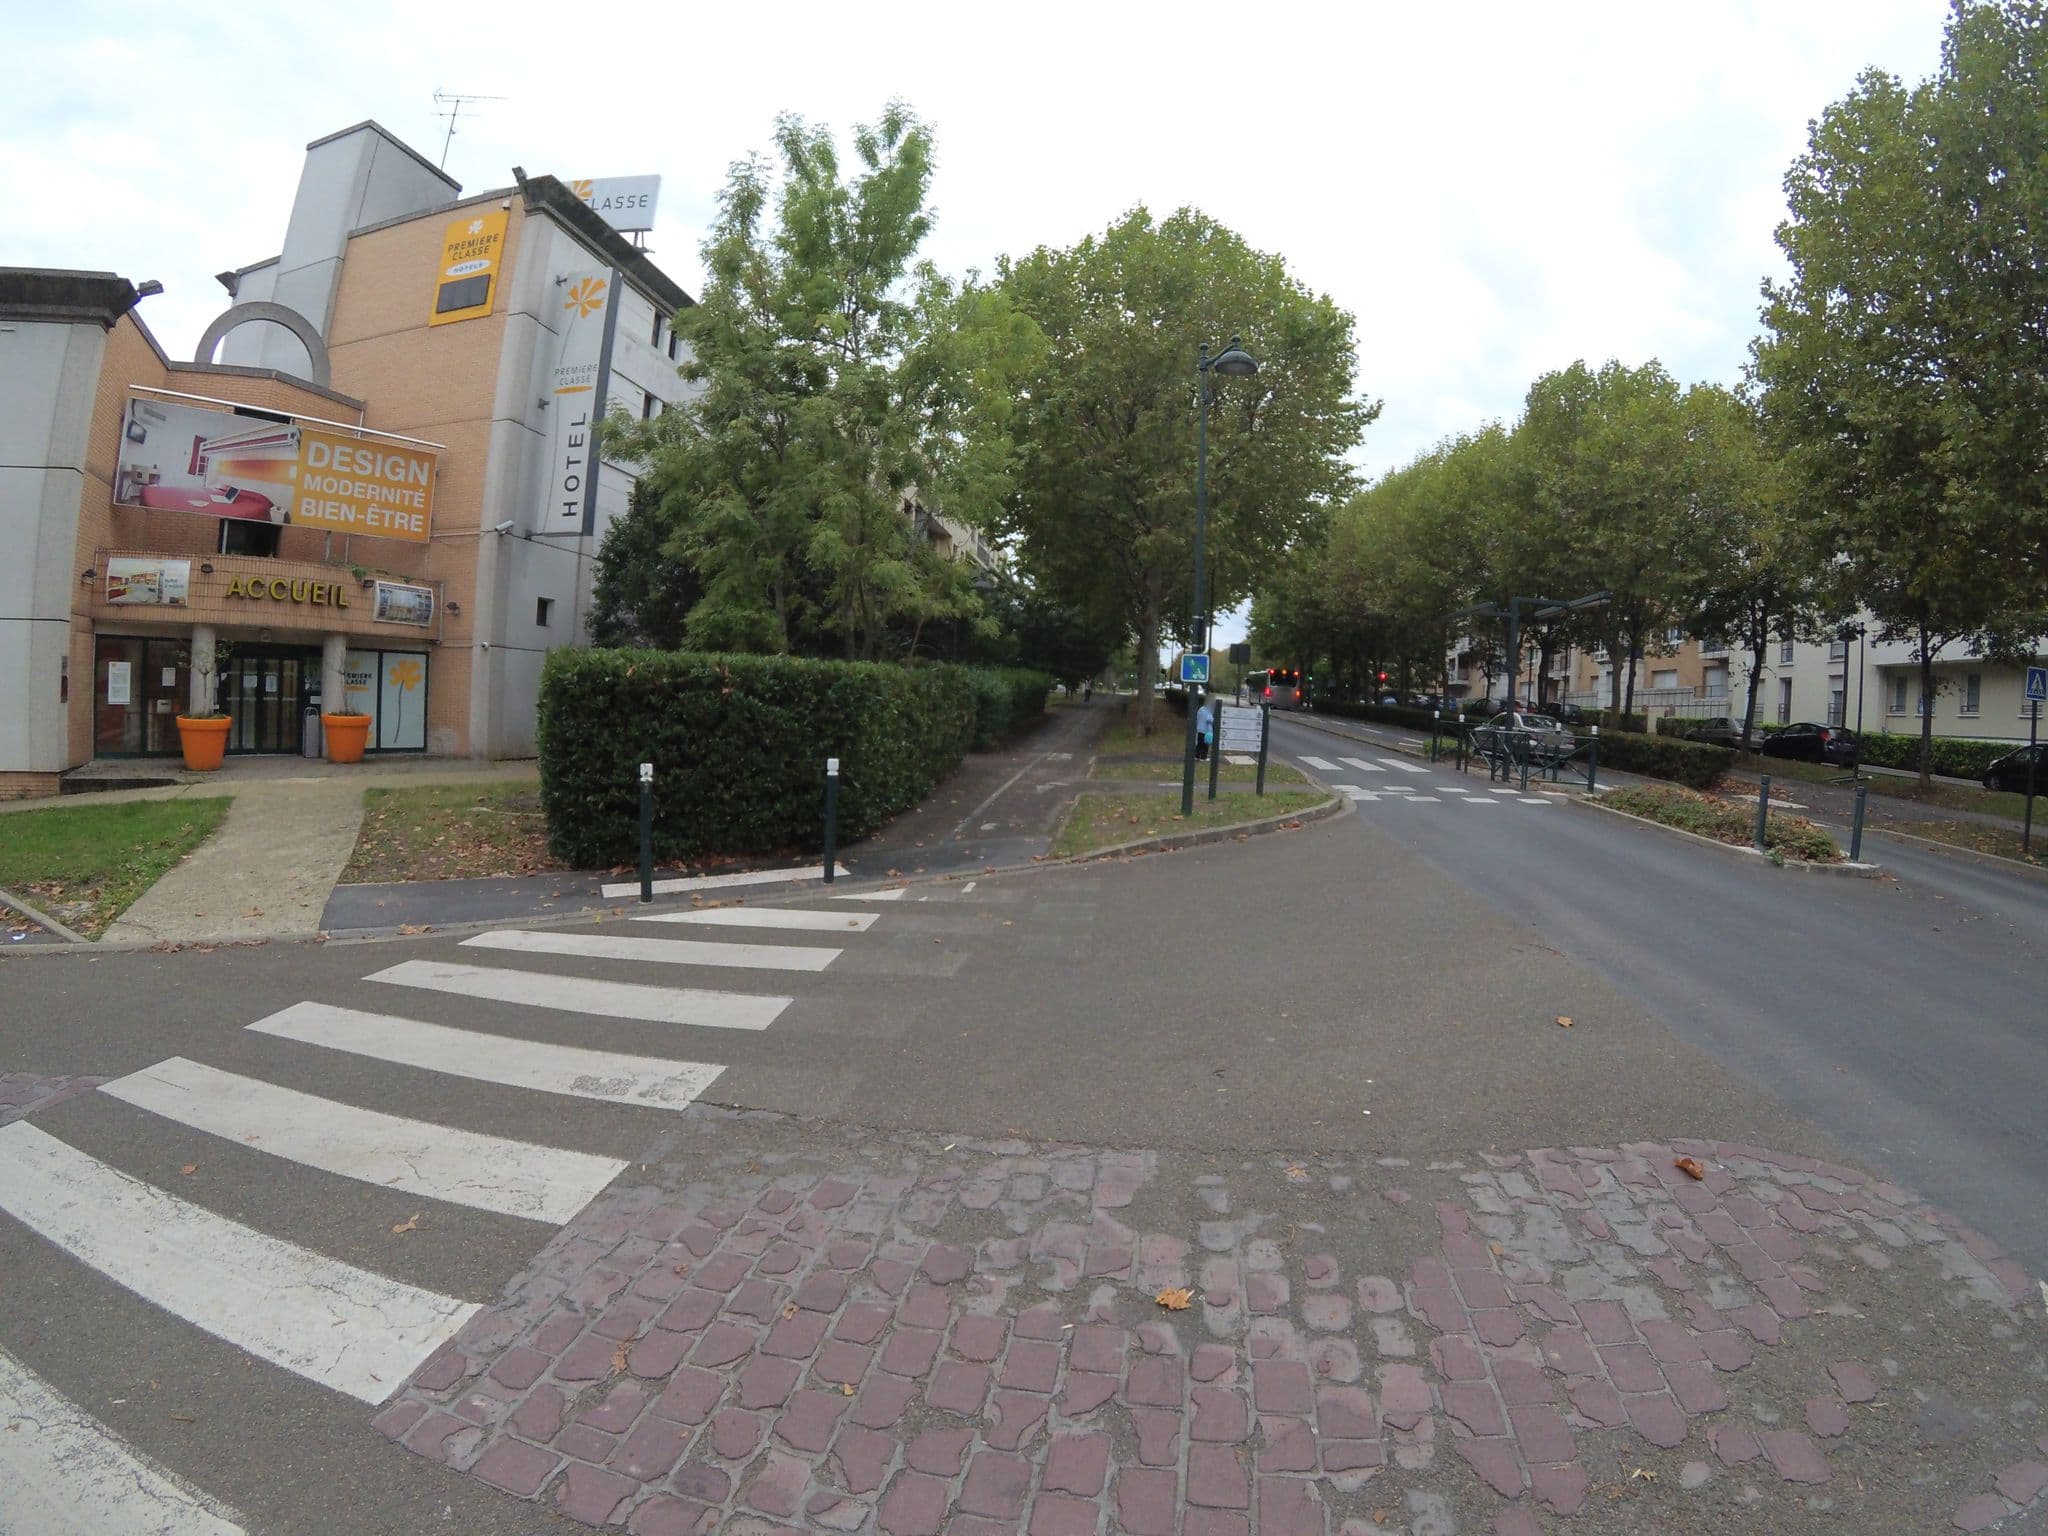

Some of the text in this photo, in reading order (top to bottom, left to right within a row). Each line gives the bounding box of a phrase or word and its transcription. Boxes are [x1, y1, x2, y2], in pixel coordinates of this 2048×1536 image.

[452, 245, 490, 260] CLASSE
[559, 374, 591, 386] CLASSE
[307, 440, 430, 486] DESIGN
[562, 412, 587, 517] HOTEL
[303, 472, 426, 508] MODERNITÉ
[300, 496, 424, 533] BIEN-ÊTRE
[225, 575, 349, 608] ACCUEIL
